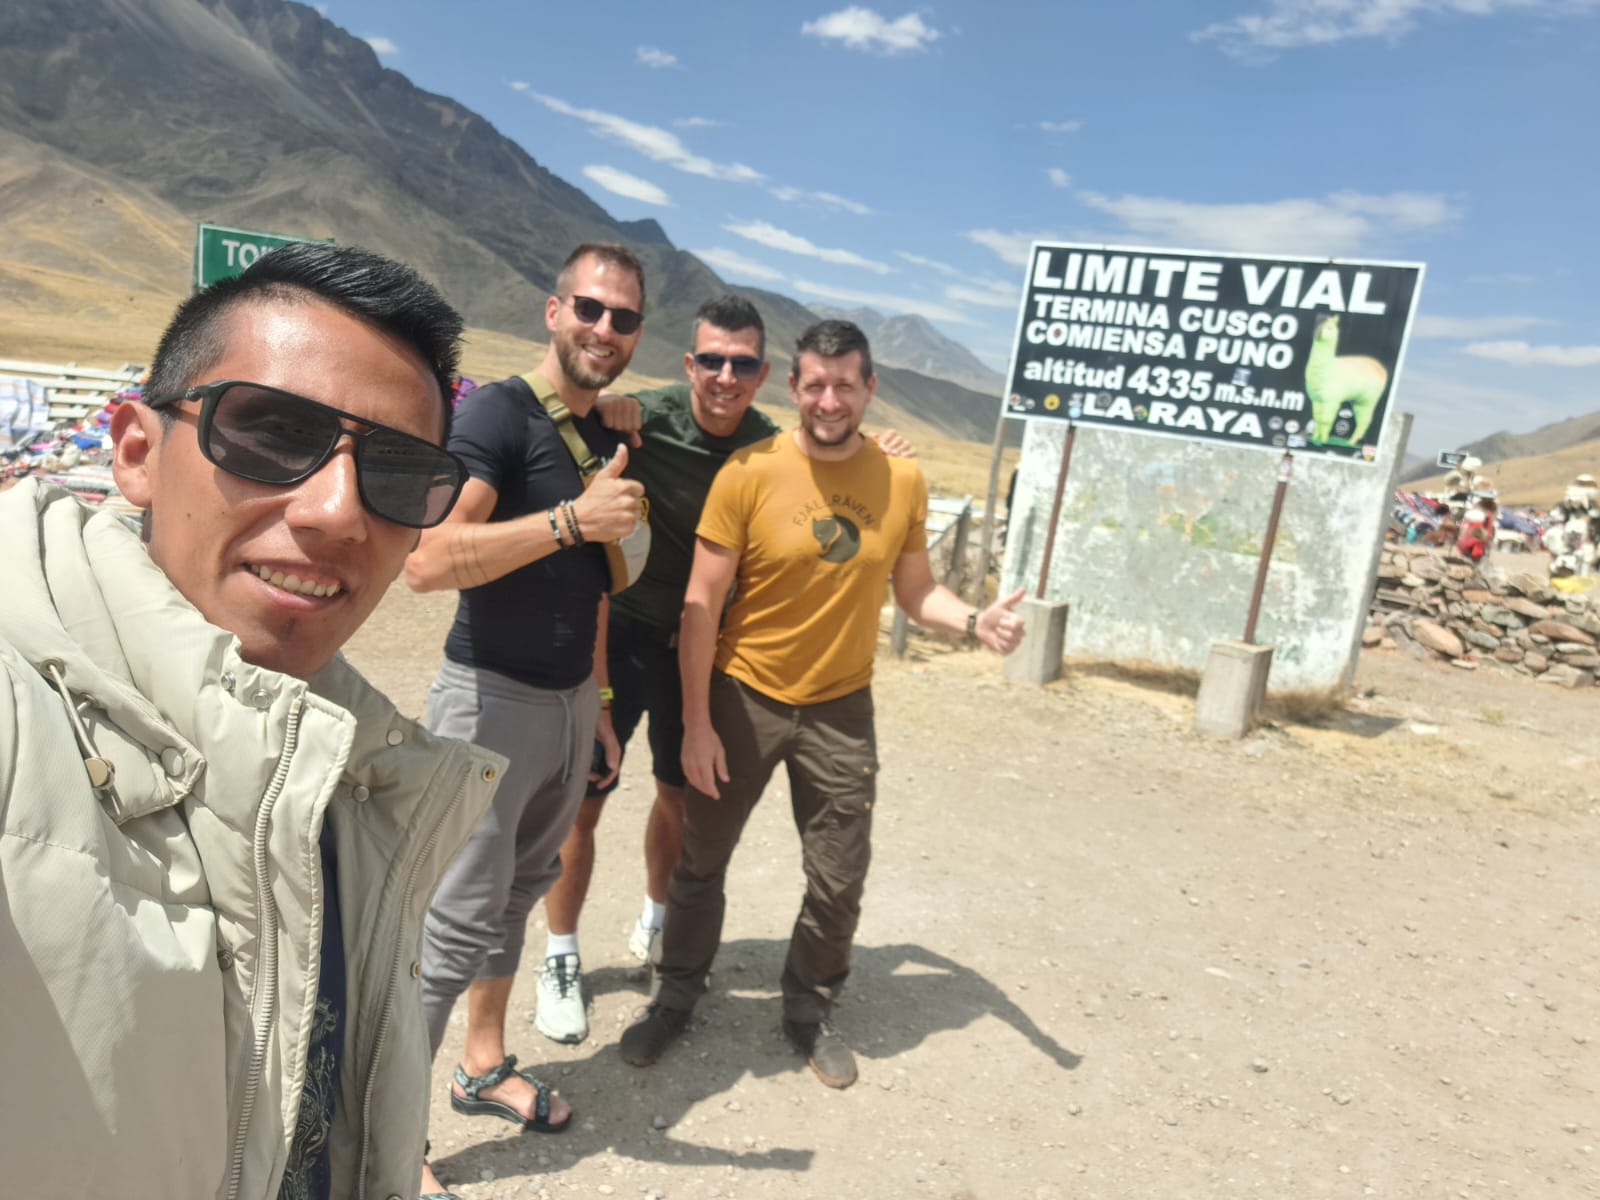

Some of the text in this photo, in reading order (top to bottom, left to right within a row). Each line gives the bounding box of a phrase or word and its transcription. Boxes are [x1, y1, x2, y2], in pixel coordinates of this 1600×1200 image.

[1033, 251, 1387, 315] LIMITE VIAL
[1033, 294, 1298, 342] TERMINA CUSCO
[1026, 320, 1295, 370] COMIENSA PUNO
[1023, 356, 1126, 391] altitud
[1127, 364, 1214, 402] 4335
[1082, 391, 1135, 421] LA
[1147, 400, 1264, 438] RAYA
